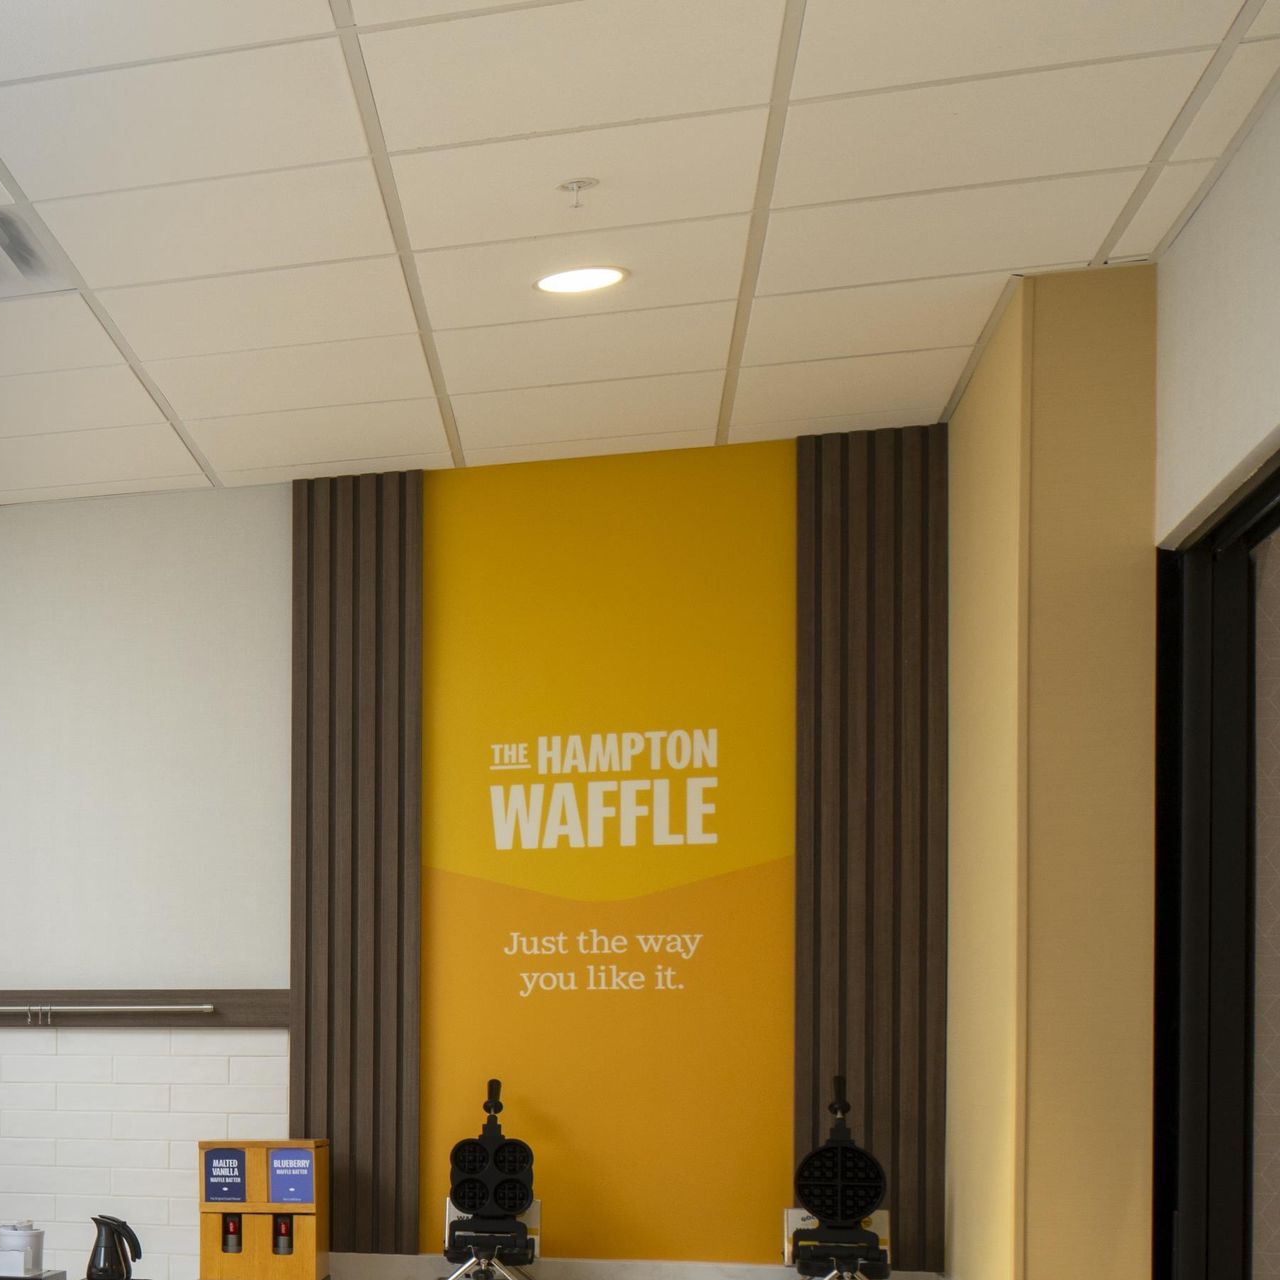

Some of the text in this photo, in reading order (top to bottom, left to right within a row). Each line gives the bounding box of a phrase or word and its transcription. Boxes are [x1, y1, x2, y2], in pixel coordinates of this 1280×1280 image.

[490, 728, 718, 775] THE HAMPTON
[489, 776, 718, 850] WAFFLE
[503, 928, 703, 959] Just the way
[519, 965, 684, 998] you like it.
[211, 1168, 239, 1176] VANILLA
[212, 1159, 238, 1167] MALTED
[273, 1159, 310, 1168] BLUEBERRY
